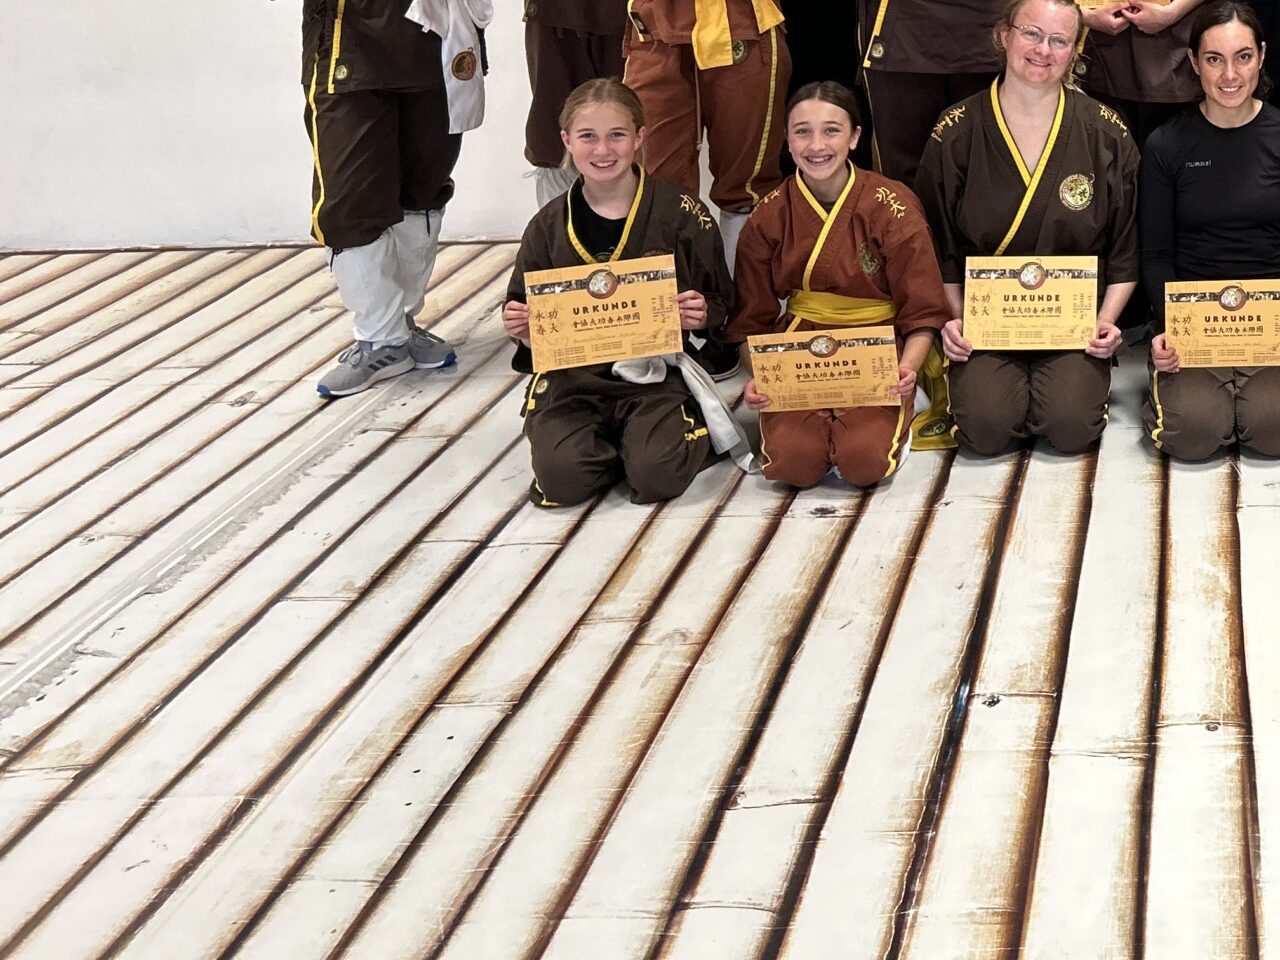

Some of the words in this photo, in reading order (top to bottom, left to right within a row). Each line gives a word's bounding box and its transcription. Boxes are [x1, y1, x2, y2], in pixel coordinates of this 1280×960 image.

[1003, 294, 1060, 302] URKUNDE
[573, 300, 637, 315] URKUNDE
[795, 359, 857, 369] URKUNDE
